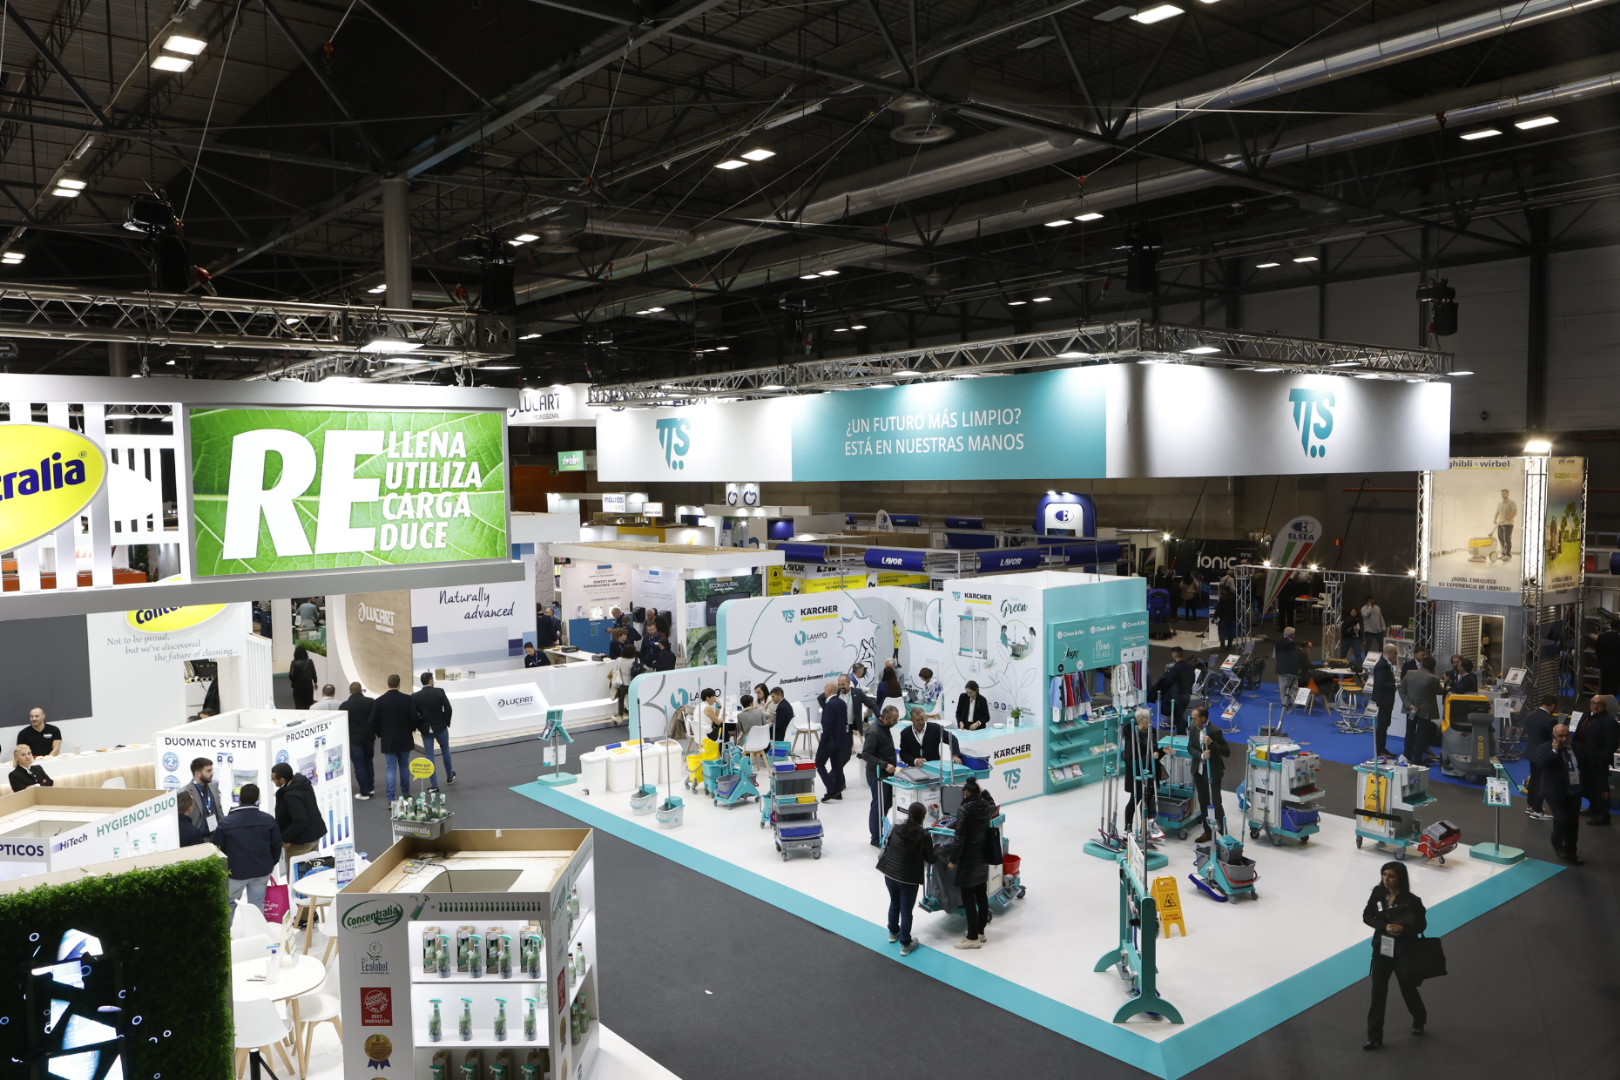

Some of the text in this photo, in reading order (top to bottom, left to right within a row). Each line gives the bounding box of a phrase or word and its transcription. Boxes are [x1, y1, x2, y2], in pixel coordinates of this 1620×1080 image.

[846, 407, 1021, 435] ¿UN FUTURO MÁS LIMPIO?
[387, 430, 468, 460] LLENA
[845, 433, 1025, 456] ESTÁ EN NUESTRAS MANOS
[1480, 460, 1510, 468] wirbel
[385, 461, 483, 491] UTILIZA
[222, 428, 386, 561] RE
[382, 492, 471, 520] CARGA
[380, 521, 448, 551] DUCE
[1288, 533, 1315, 541] ELSEA
[882, 556, 903, 566] LAVOR
[1000, 558, 1022, 567] LAVOR
[1197, 552, 1237, 570] ionic
[439, 587, 490, 608] Naturally
[366, 606, 396, 626] LUCART
[464, 602, 515, 620] advanced
[800, 605, 838, 616] KÄRCHER
[1000, 599, 1028, 618] Green
[107, 636, 121, 646] Not
[124, 637, 132, 645] to
[133, 634, 142, 644] be
[125, 646, 139, 655] but
[162, 640, 200, 652] discovered
[154, 654, 167, 662] the
[167, 652, 192, 664] future
[193, 650, 202, 659] of
[505, 696, 534, 707] LUCART
[690, 688, 722, 702] LAO
[165, 737, 257, 750] DUOMATIC SYSTEM
[994, 744, 1031, 760] KÄRCHER
[154, 797, 176, 814] DUO
[394, 824, 430, 835] Concentralia
[60, 833, 88, 851] HiTech
[347, 904, 398, 927] Concentralia
[361, 961, 388, 972] Ecolabel
